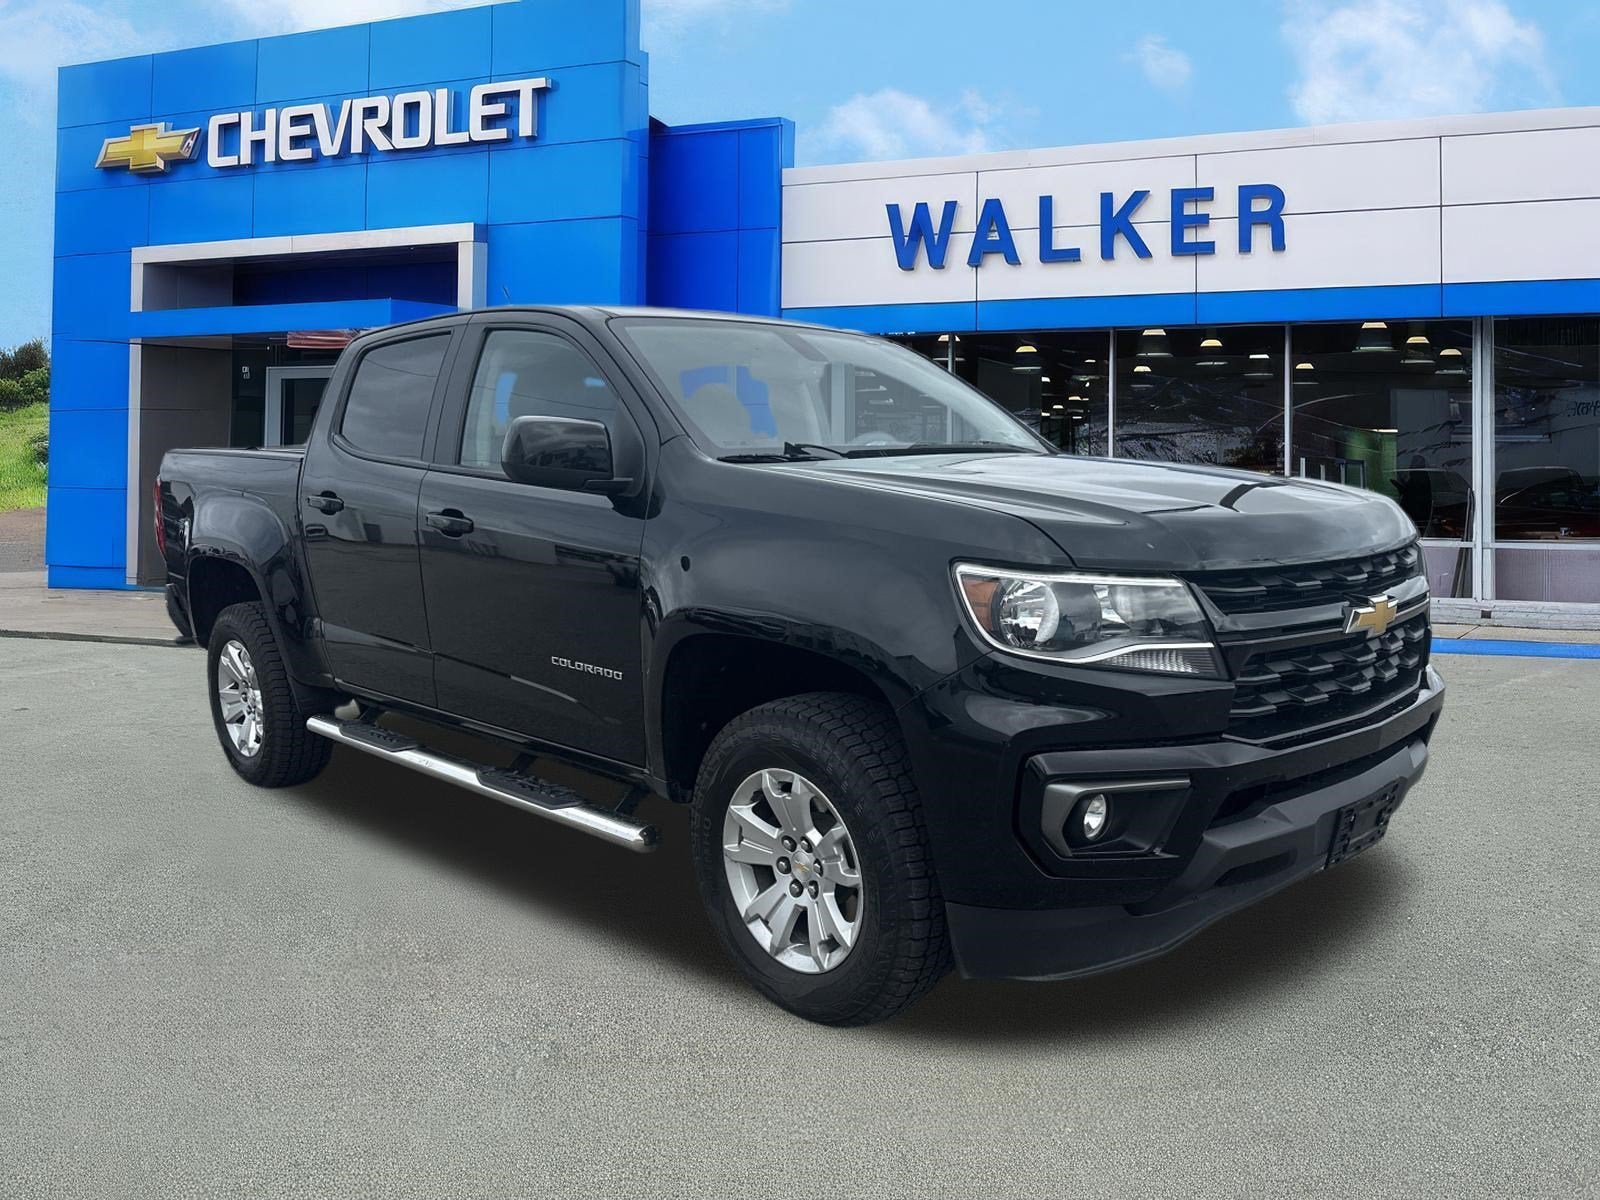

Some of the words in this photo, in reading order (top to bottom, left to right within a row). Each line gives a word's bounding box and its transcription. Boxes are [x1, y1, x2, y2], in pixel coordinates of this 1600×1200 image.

[206, 77, 551, 168] CHEVROLET
[885, 183, 1287, 271] WALKER
[551, 655, 623, 681] COLORADO
